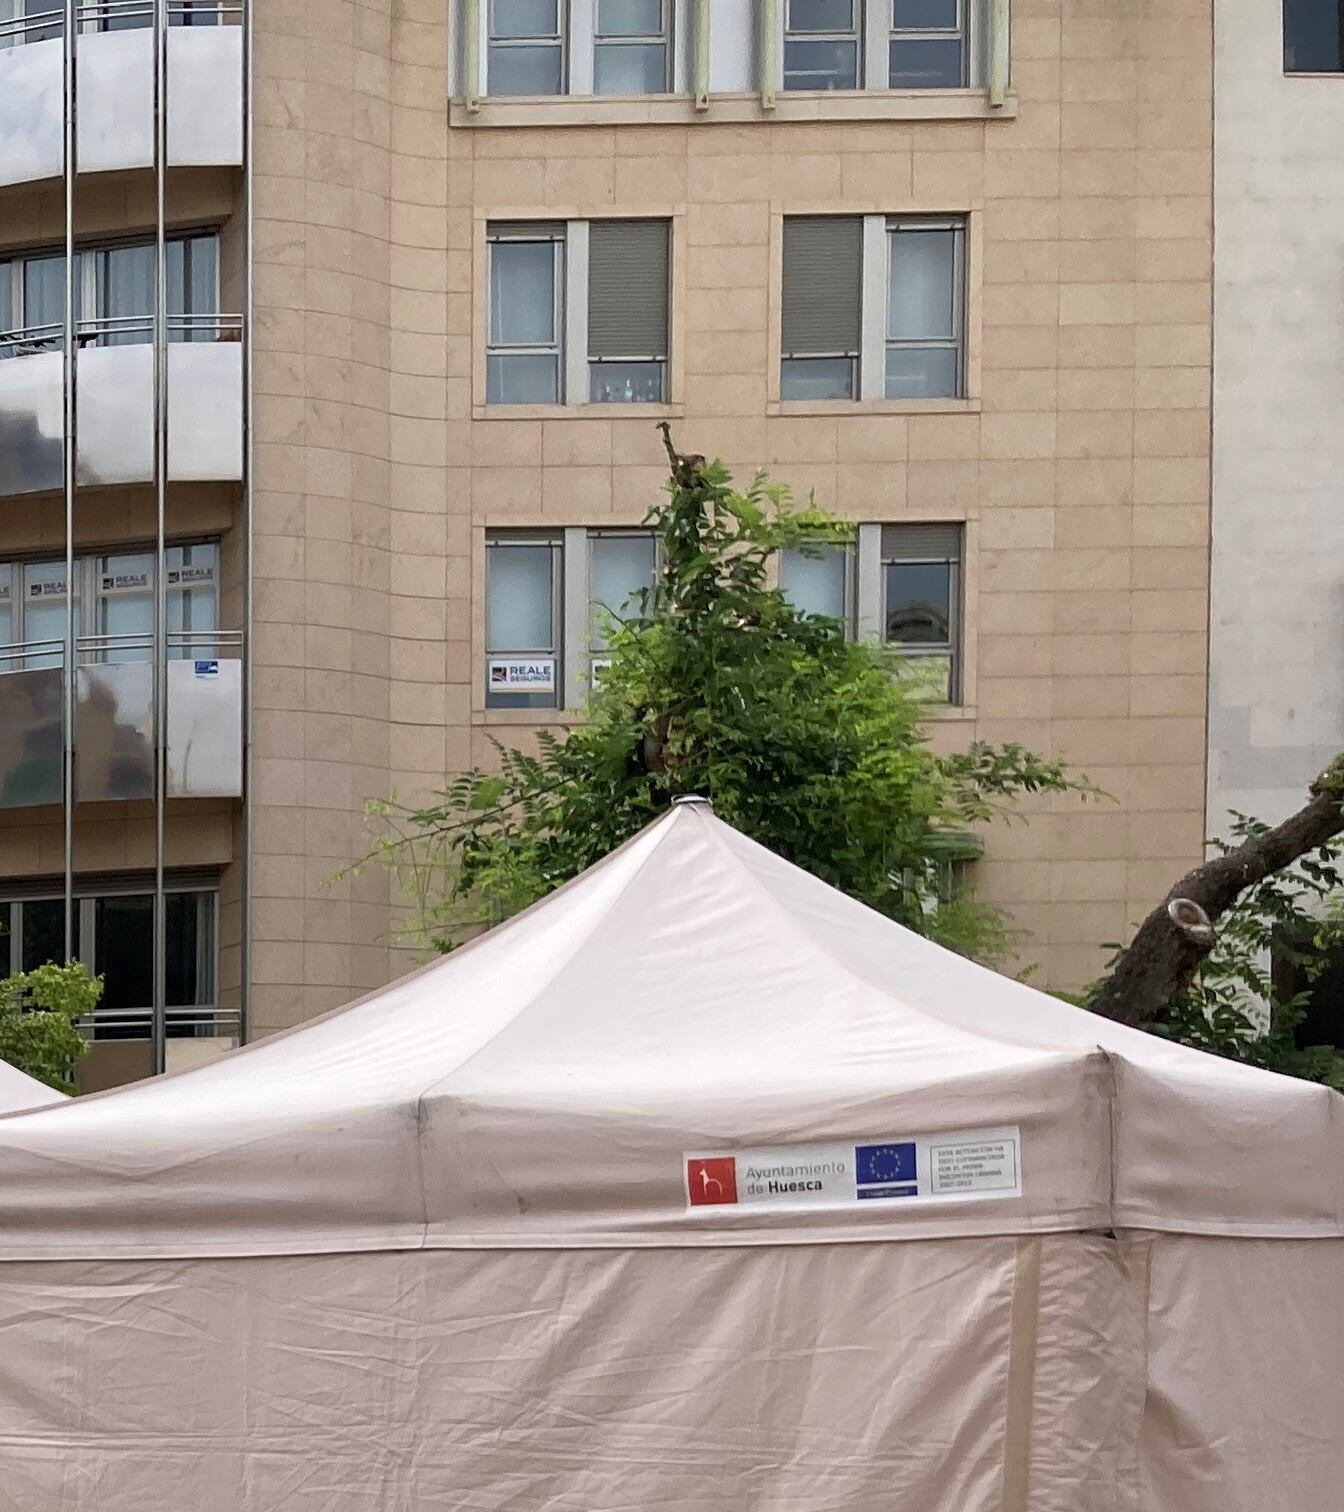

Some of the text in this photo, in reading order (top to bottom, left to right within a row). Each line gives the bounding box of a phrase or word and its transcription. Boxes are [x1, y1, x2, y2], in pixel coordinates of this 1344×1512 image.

[509, 665, 551, 675] REALE
[746, 1162, 845, 1180] Ayuntamiento
[747, 1179, 823, 1195] de Huesca
